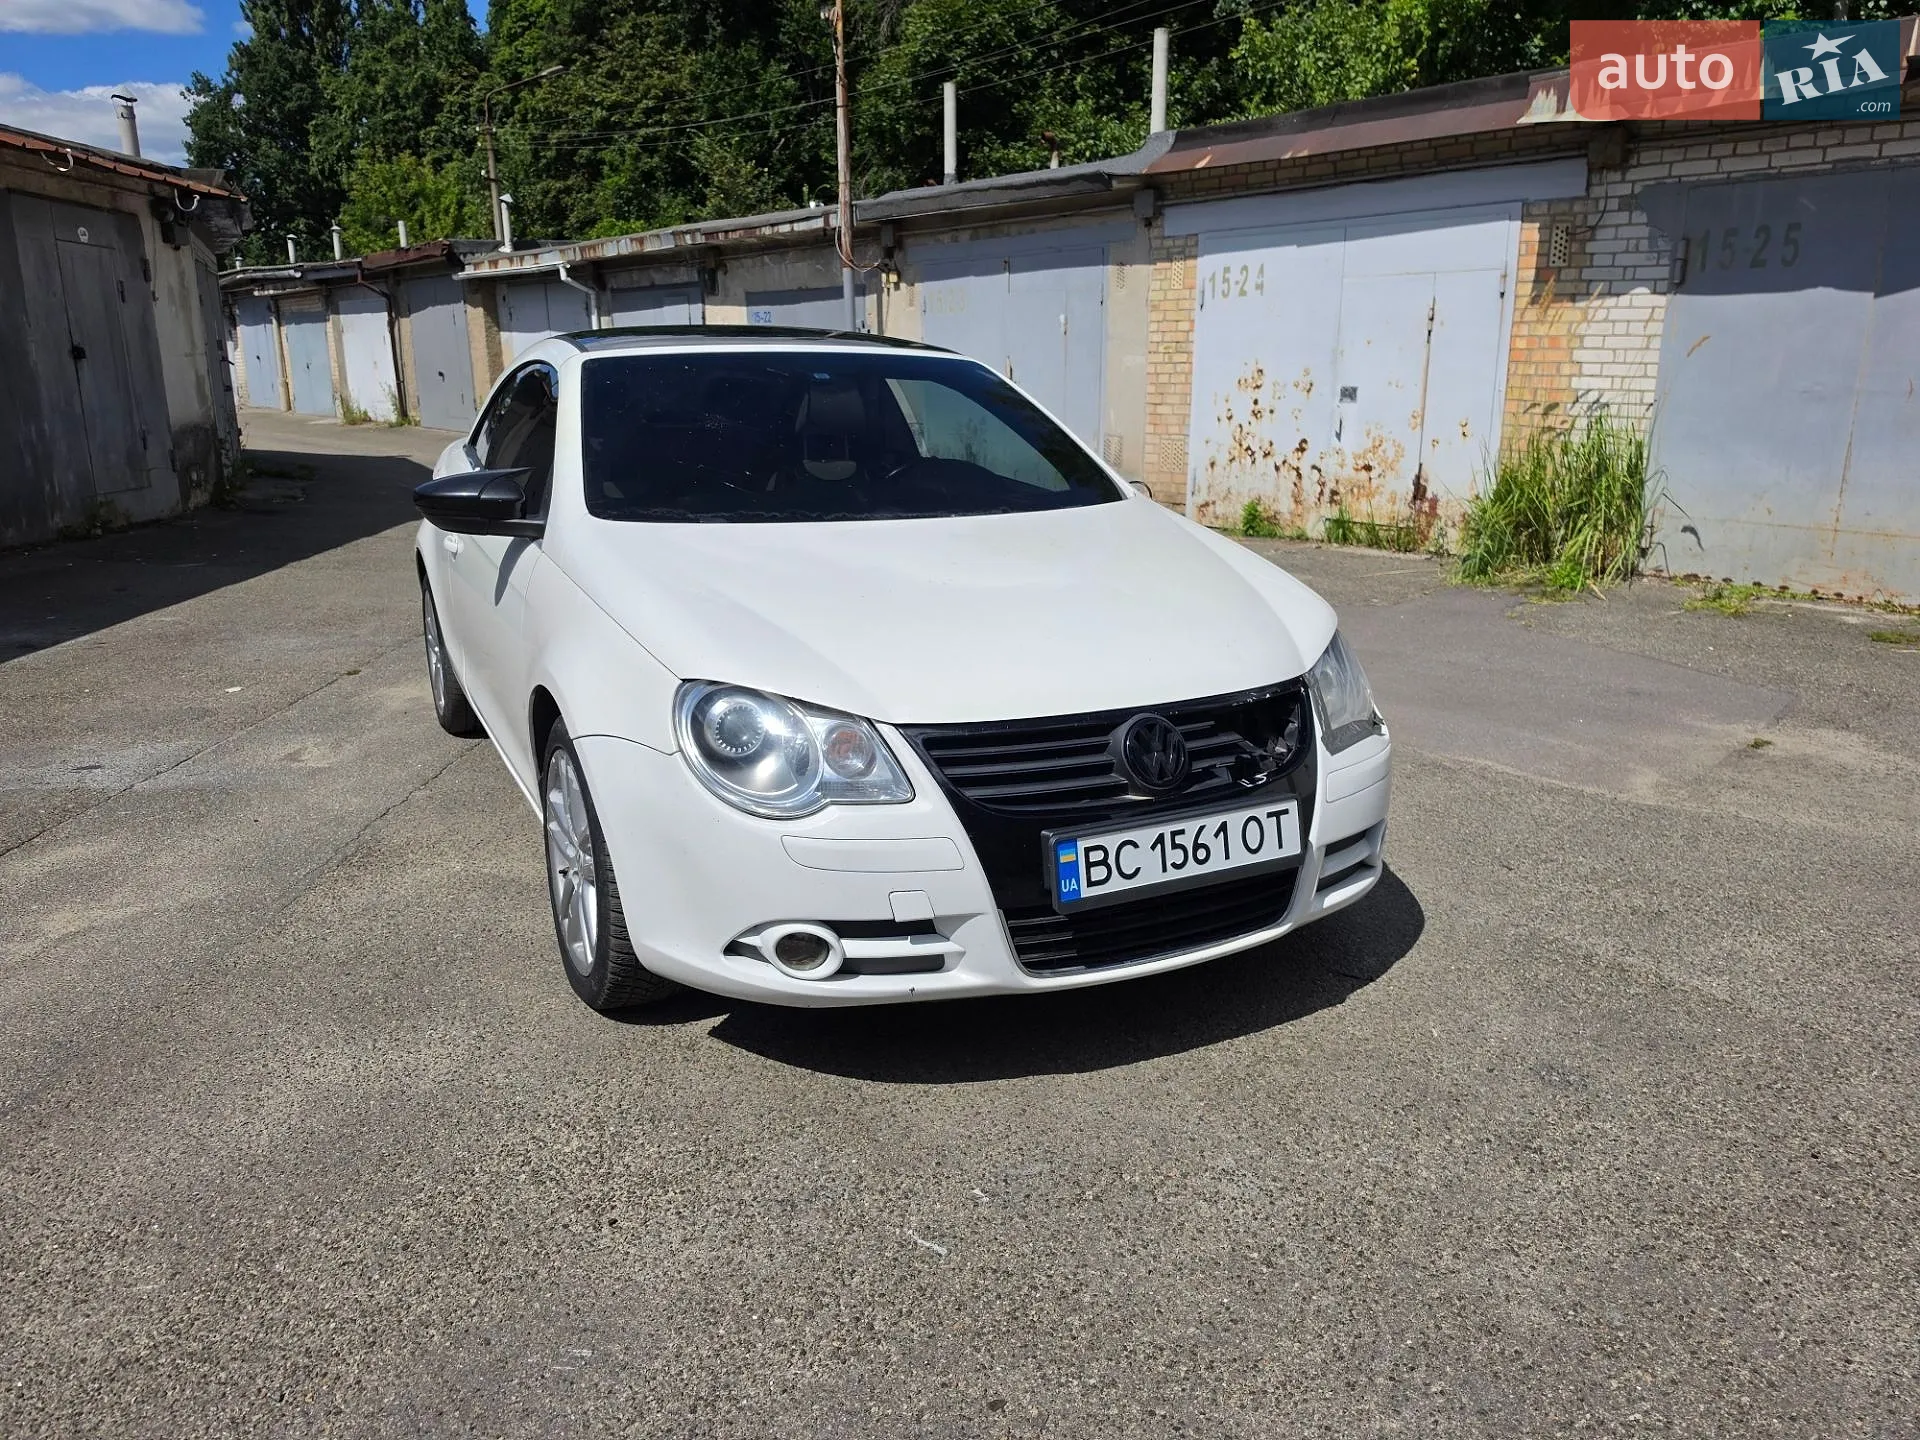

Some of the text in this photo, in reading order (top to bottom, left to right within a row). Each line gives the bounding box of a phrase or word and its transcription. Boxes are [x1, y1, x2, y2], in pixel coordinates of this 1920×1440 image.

[1696, 222, 1802, 273] 15-25
[1208, 263, 1264, 300] 15-24
[1083, 808, 1290, 888] BC 1561 OT
[1061, 877, 1078, 893] UA
